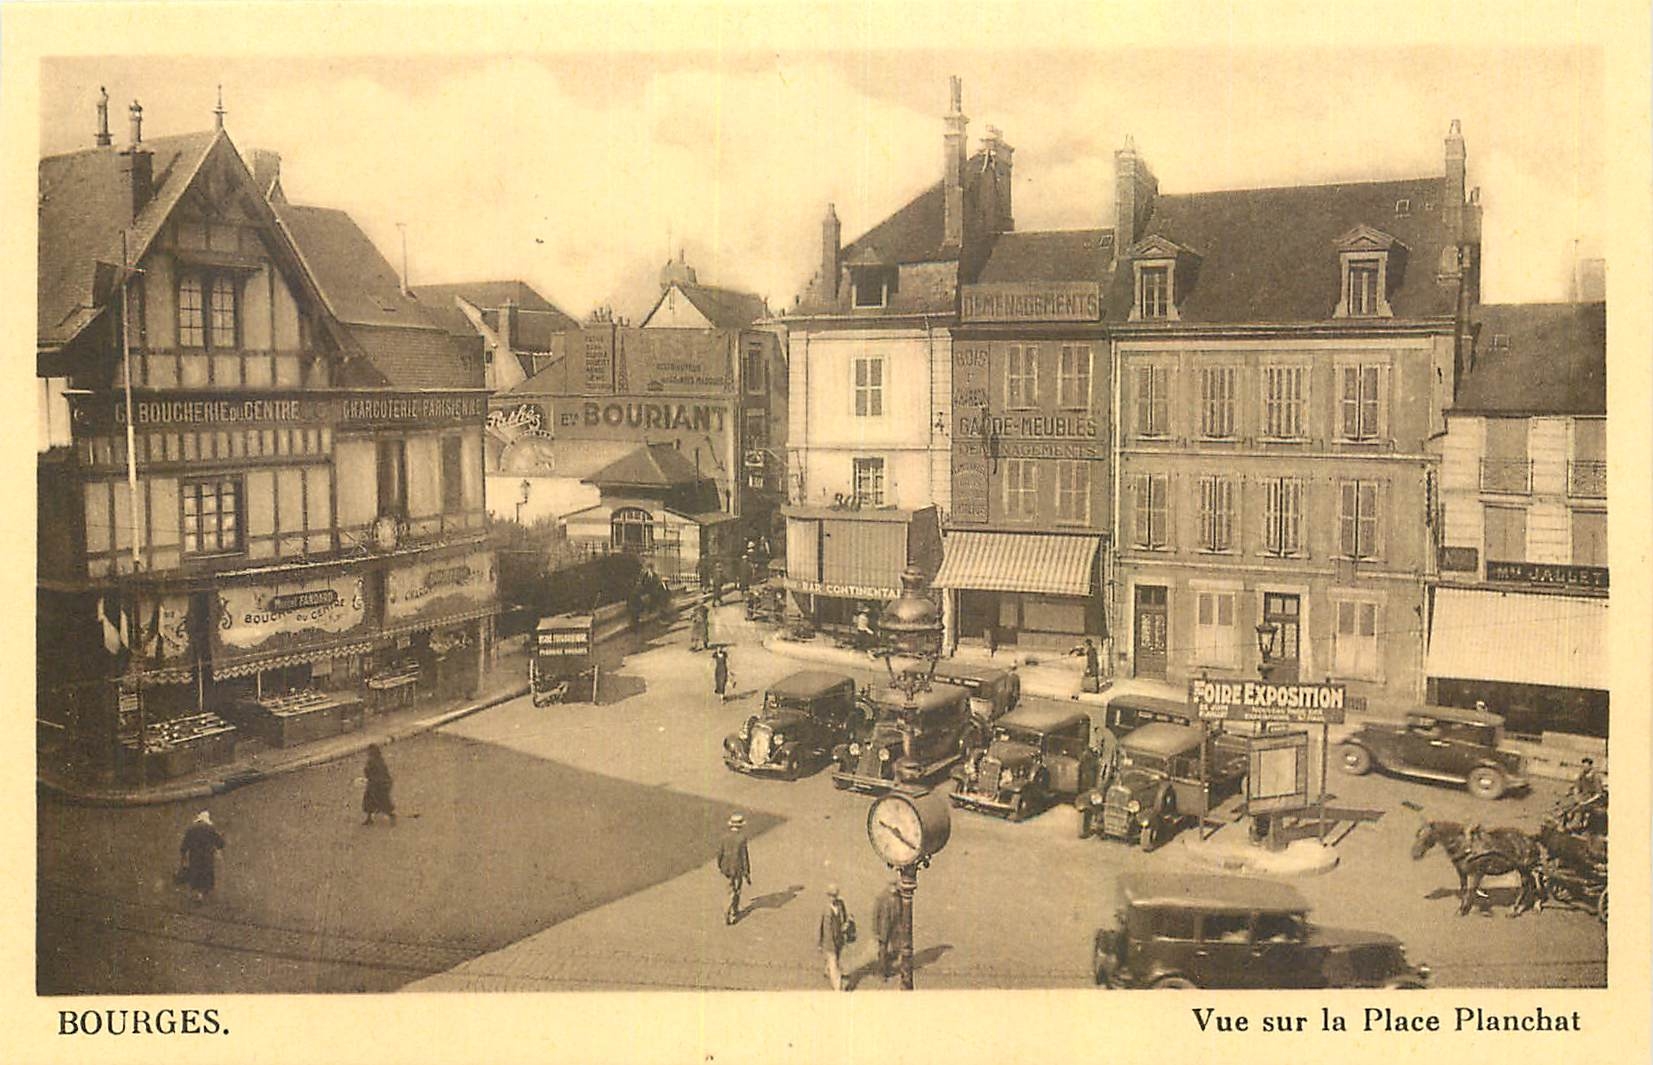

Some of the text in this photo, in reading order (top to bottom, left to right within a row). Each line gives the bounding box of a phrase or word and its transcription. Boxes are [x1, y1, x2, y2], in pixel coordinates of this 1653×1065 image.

[139, 402, 229, 423] BOUCHERIE
[244, 400, 300, 421] CENTRE
[343, 399, 418, 418] CHARCUTERIE
[584, 402, 728, 431] BOURIANT
[1194, 681, 1344, 708] FOIRE EXPOSITION
